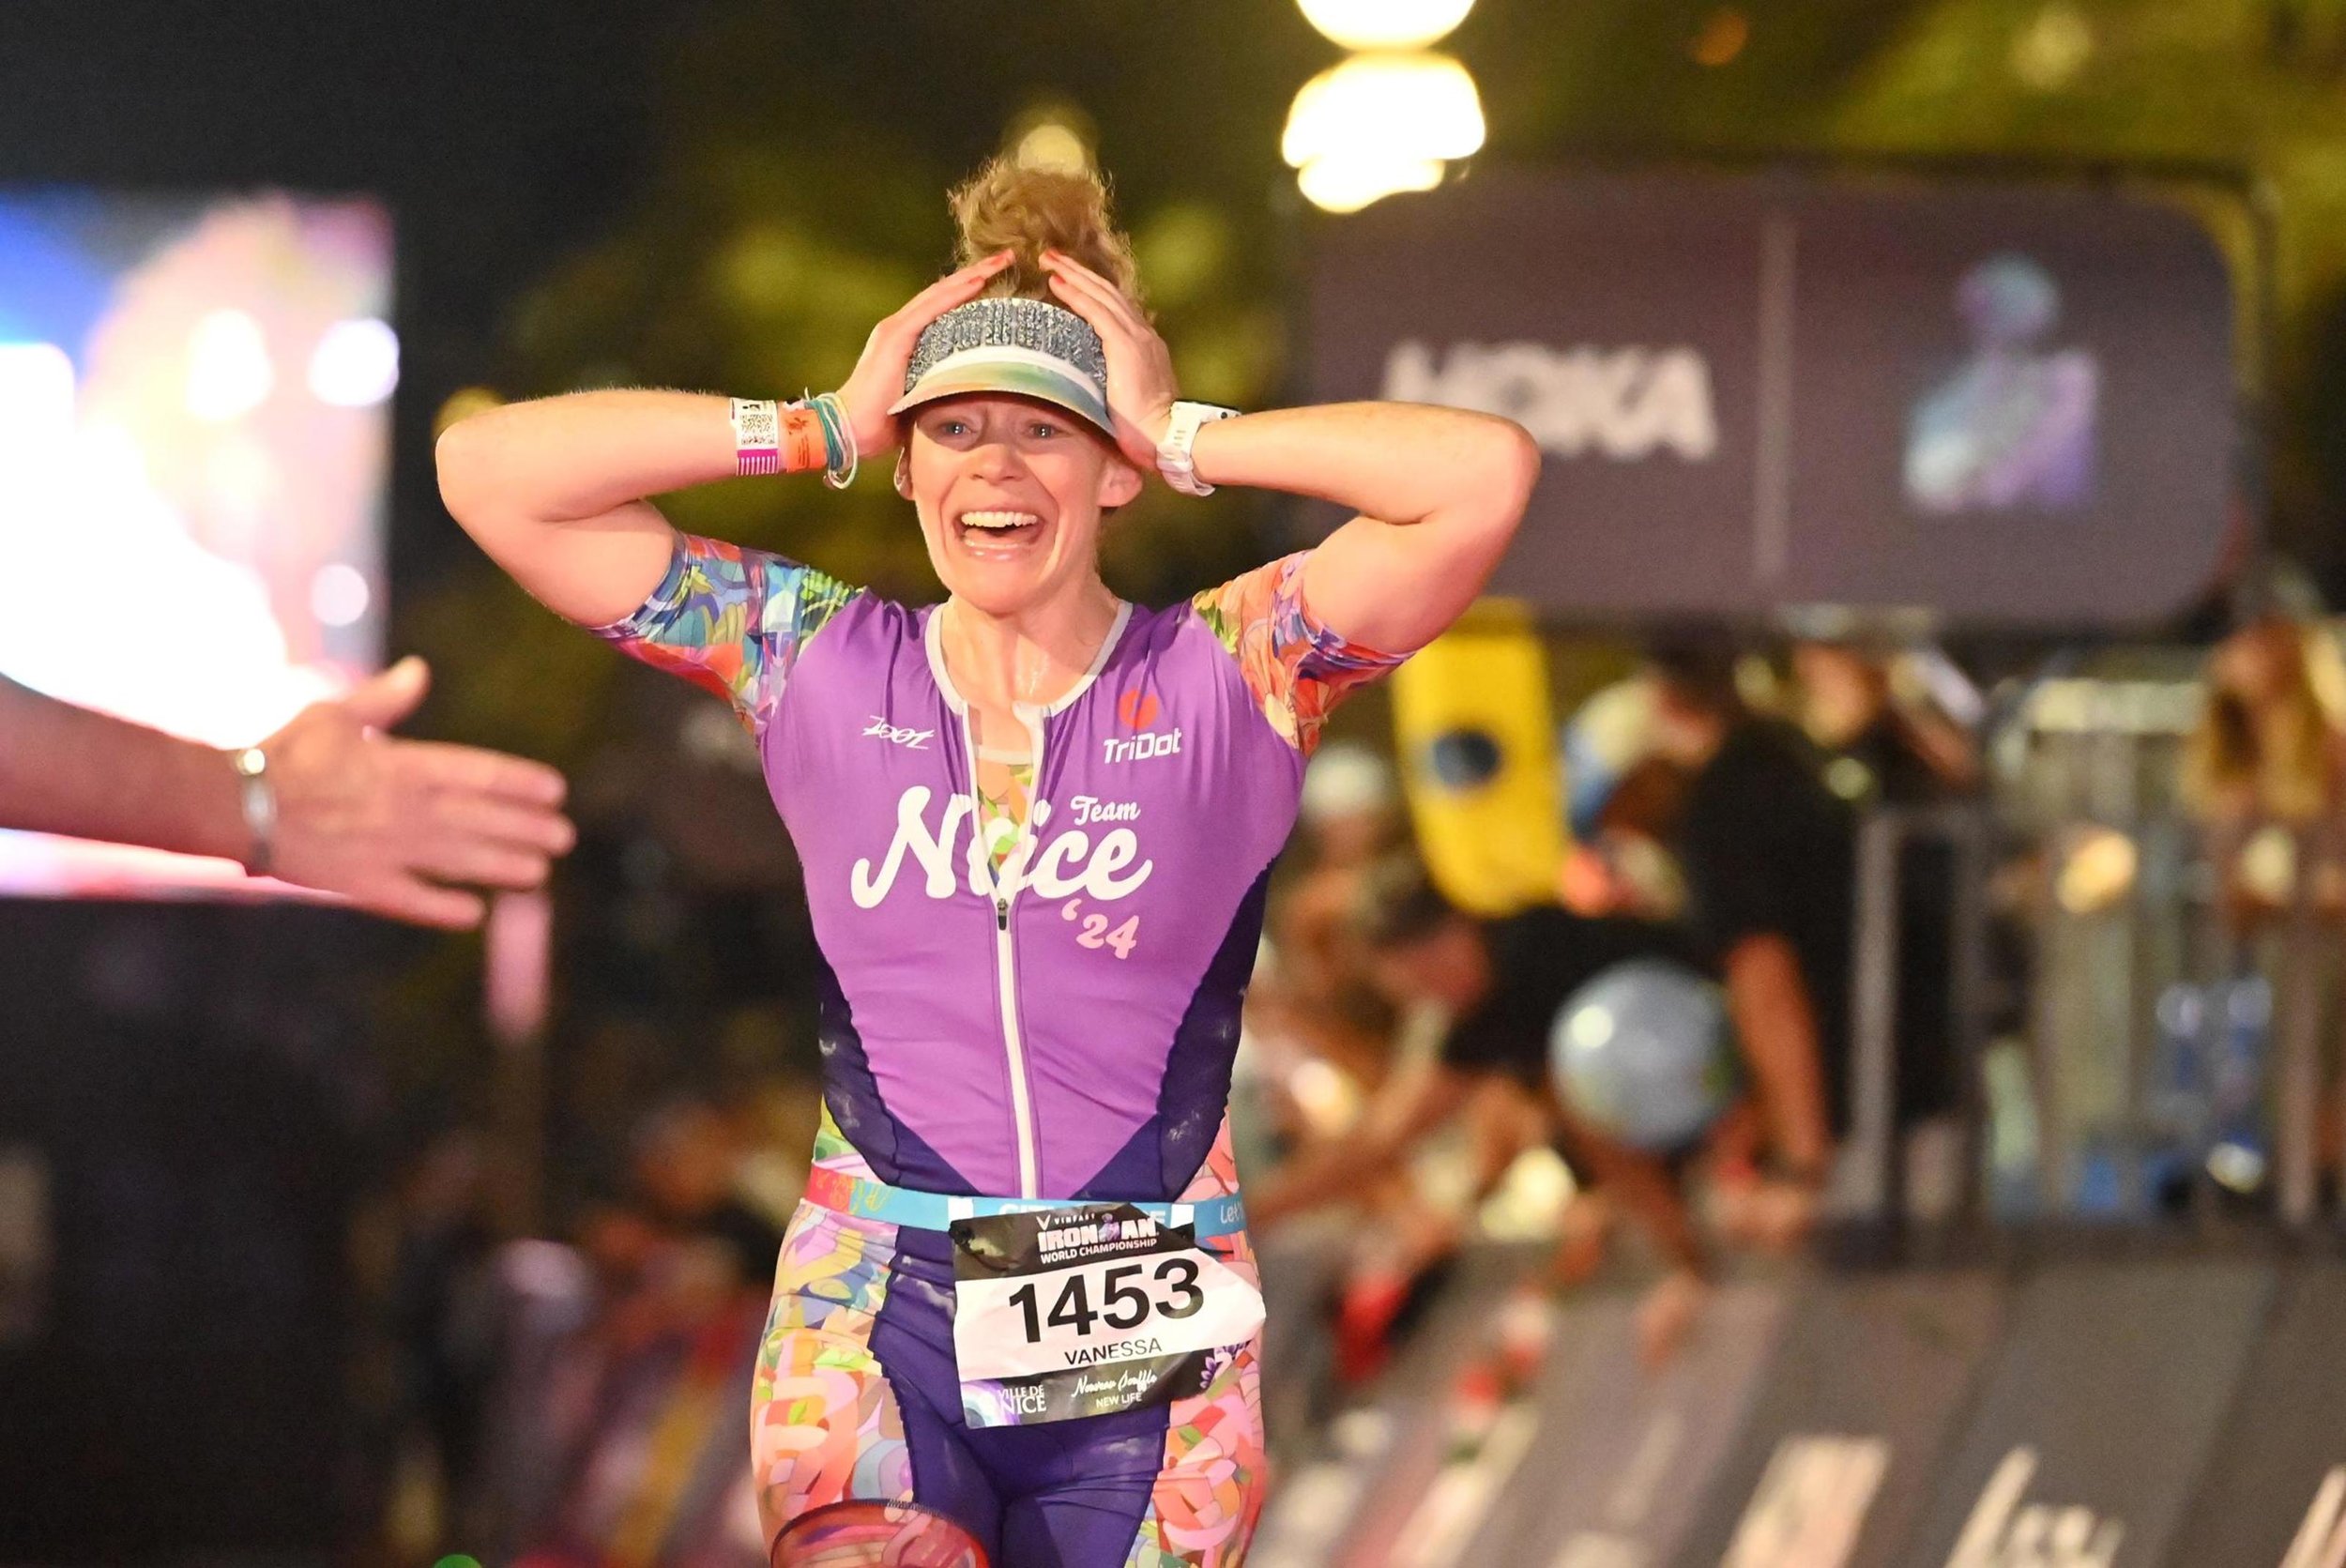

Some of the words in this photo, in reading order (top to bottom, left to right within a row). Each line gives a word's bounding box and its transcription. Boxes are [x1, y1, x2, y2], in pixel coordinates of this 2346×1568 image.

[1104, 728, 1182, 764] TriDot
[1070, 796, 1141, 826] Team
[1040, 1248, 1078, 1265] WORLD
[1079, 1238, 1158, 1256] CHAMPIONSHIP
[1009, 1258, 1204, 1344] 1453
[1064, 1337, 1163, 1365] VANESSA
[998, 1386, 1028, 1400] VILLE
[1029, 1384, 1044, 1397] DE
[999, 1395, 1047, 1415] NICE
[1095, 1394, 1120, 1408] NEW
[1121, 1392, 1142, 1405] LIFE
